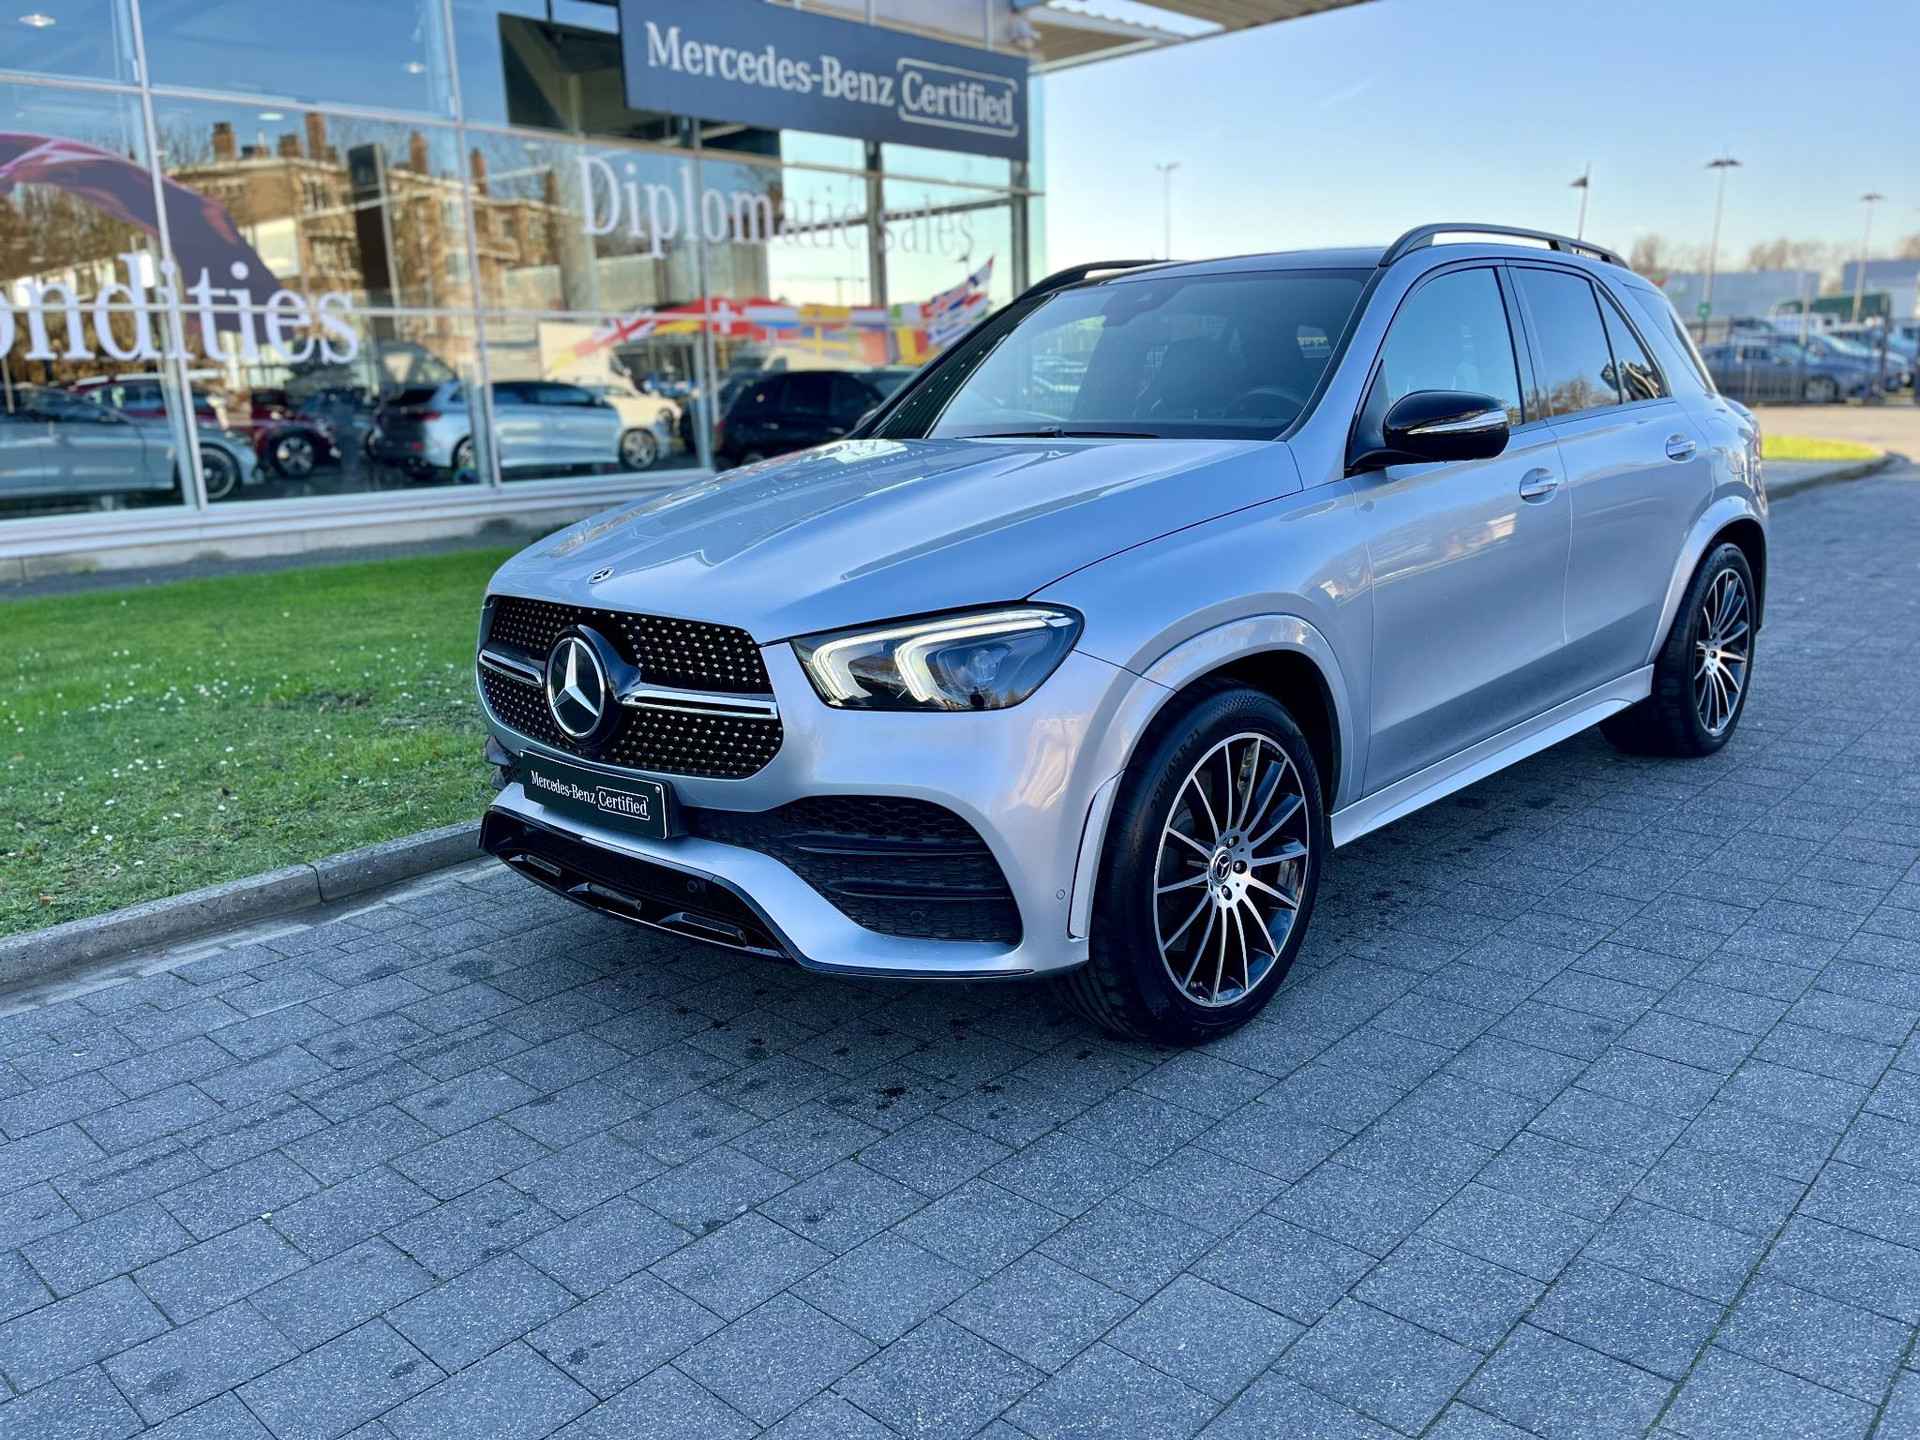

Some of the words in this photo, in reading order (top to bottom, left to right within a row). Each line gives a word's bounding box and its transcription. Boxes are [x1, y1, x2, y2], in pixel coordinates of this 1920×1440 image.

[645, 22, 896, 108] Mercedes-Benz
[901, 69, 1014, 126] Certified
[576, 156, 860, 260] Diplomatic
[0, 253, 359, 364] ndities
[531, 770, 596, 805] Mercedes-Benz
[599, 791, 648, 816] Certified
